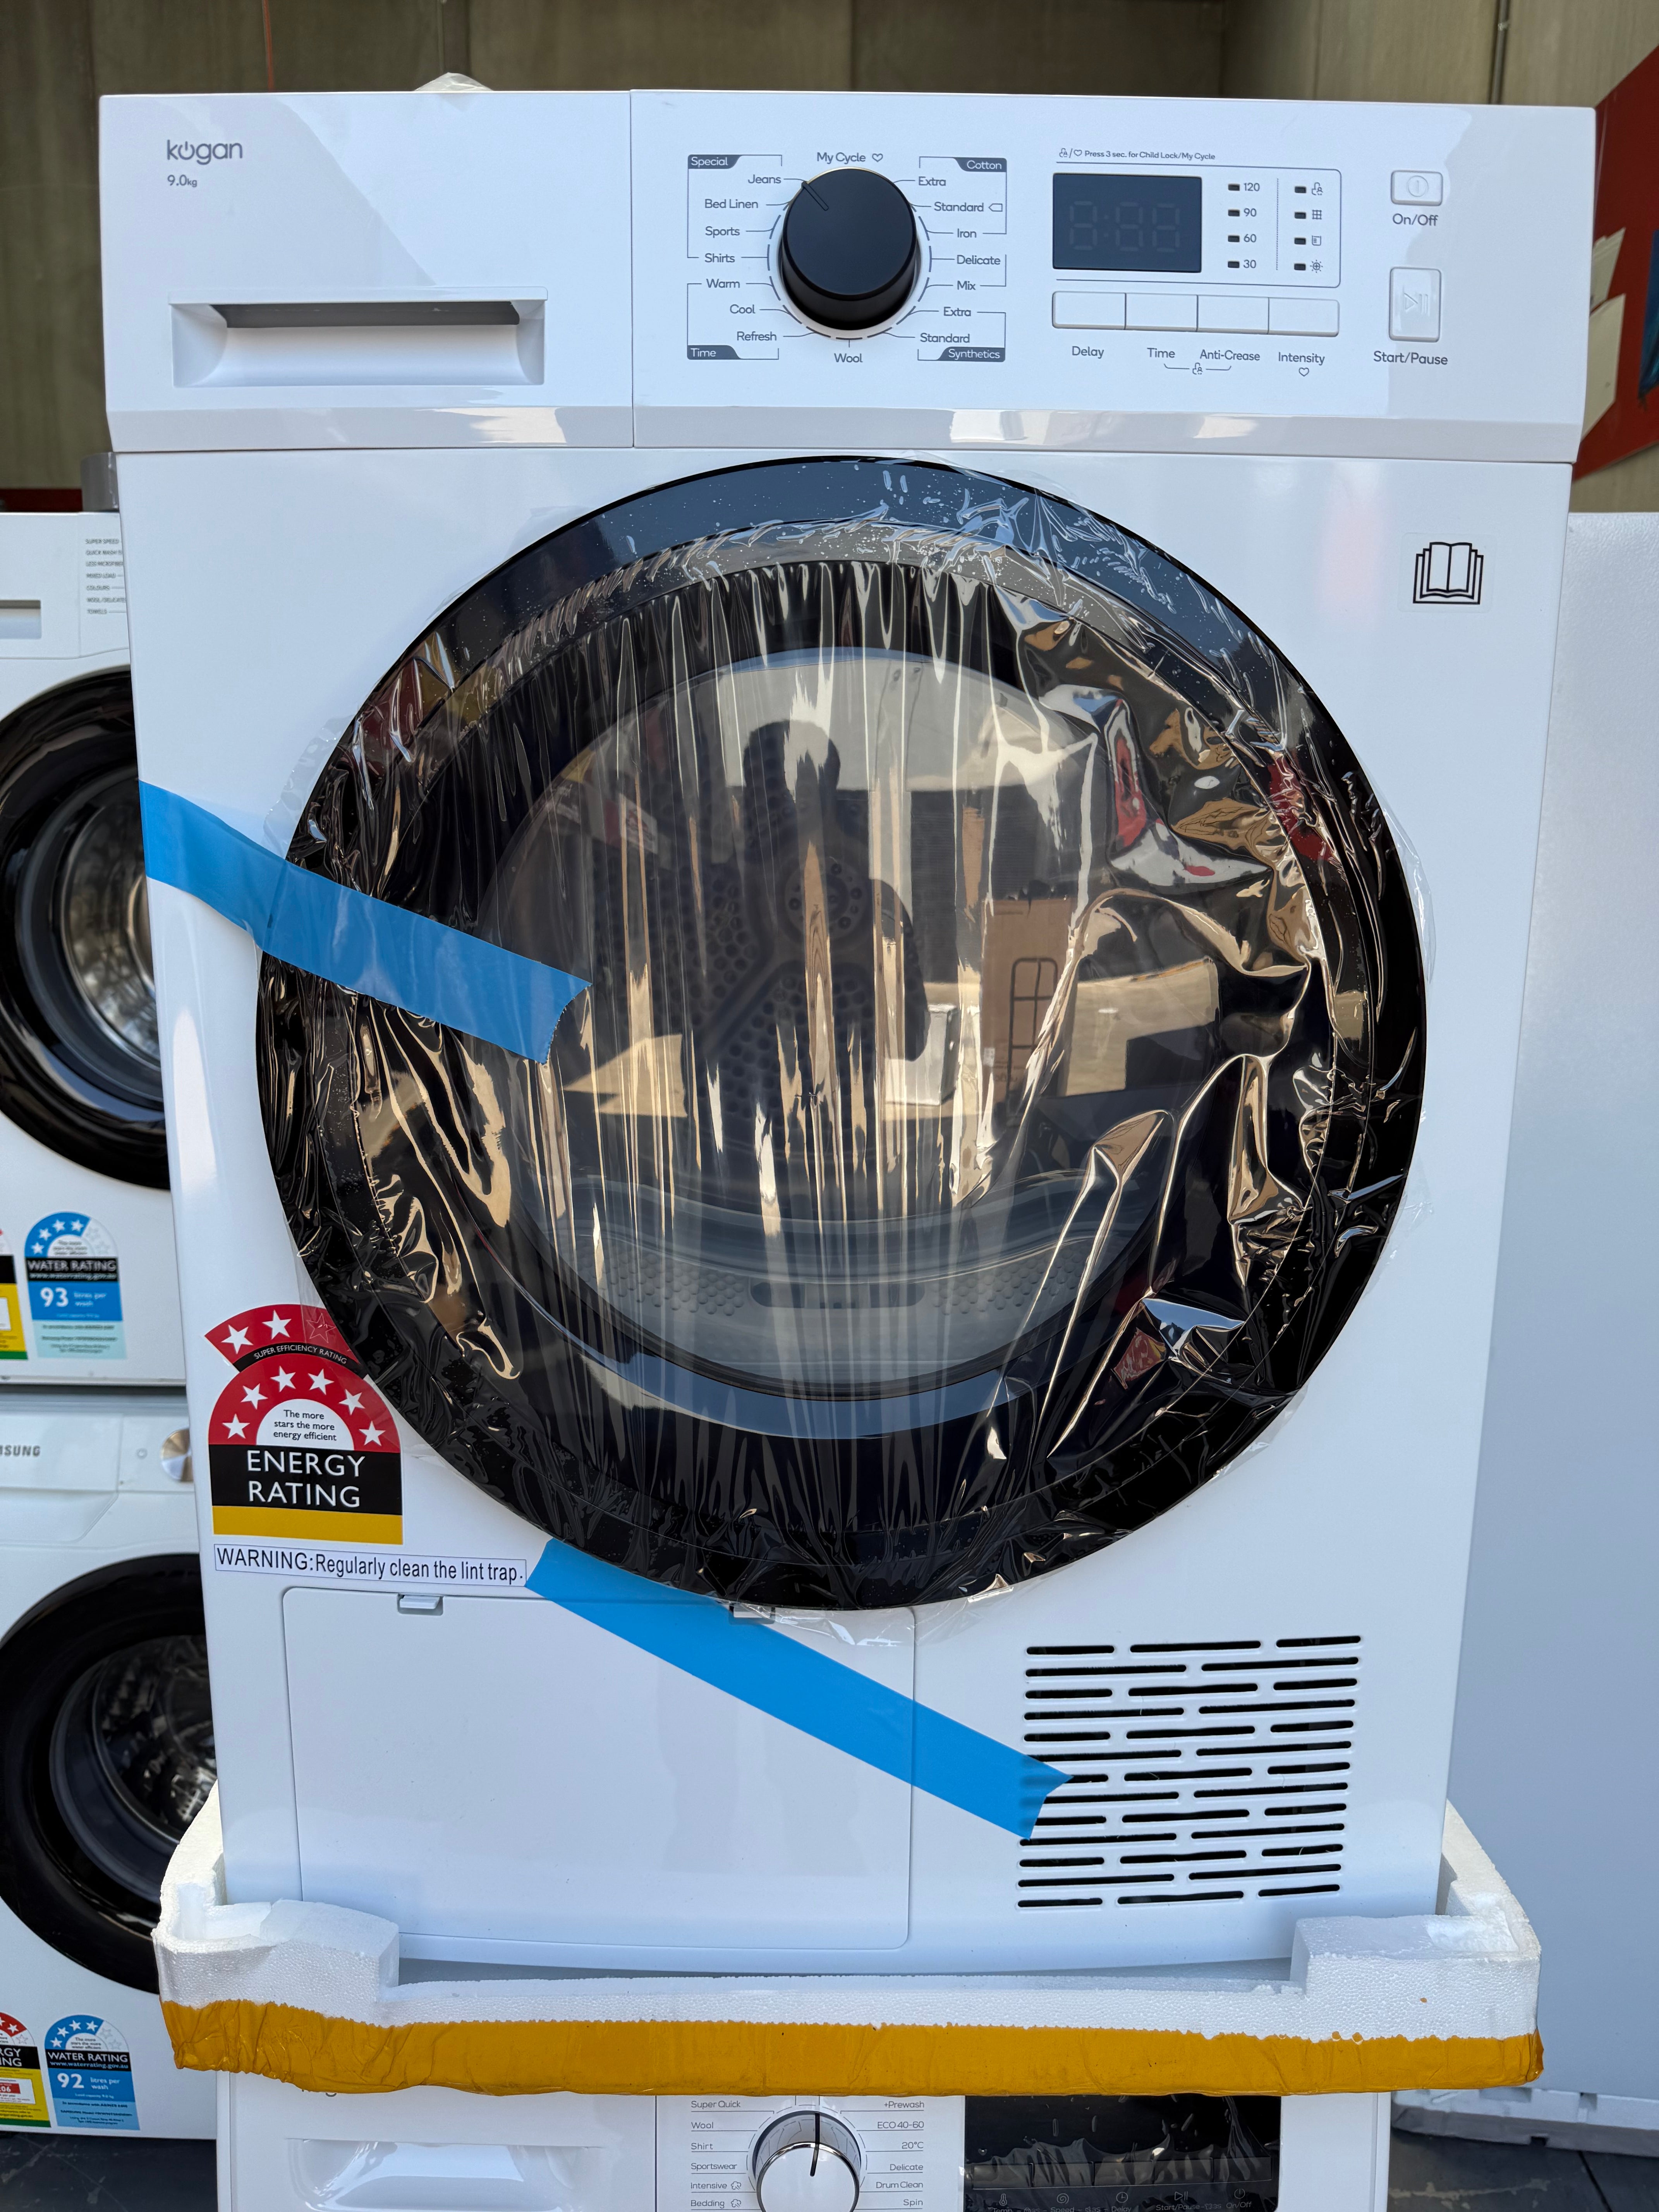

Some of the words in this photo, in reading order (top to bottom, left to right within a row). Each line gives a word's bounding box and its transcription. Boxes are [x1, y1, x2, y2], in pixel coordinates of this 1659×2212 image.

[167, 139, 243, 165] kogan
[1161, 152, 1193, 160] Lock/My
[1194, 153, 1215, 161] Cycle
[691, 156, 728, 167] Special
[817, 152, 833, 164] My
[836, 152, 866, 164] Cycle
[967, 160, 1002, 170] Cotton
[167, 175, 198, 187] 9.0kg
[748, 175, 781, 184] Jeans
[919, 177, 946, 187] Extra
[1243, 182, 1261, 192] 120
[705, 199, 727, 209] Bed
[729, 199, 758, 209] Linen
[934, 202, 984, 212] Standard
[1243, 208, 1257, 218] 90
[1392, 213, 1439, 226] On/Off
[705, 227, 740, 238] Sports
[957, 229, 977, 239] Iron
[1243, 234, 1257, 244] 60
[704, 253, 735, 263] Shirts
[957, 255, 1001, 266] Delicate
[1243, 260, 1257, 270] 30
[706, 279, 740, 289] Warm
[957, 281, 976, 291] Mix
[730, 305, 755, 314] Cool
[943, 307, 971, 317] Extra
[737, 331, 777, 342] Refresh
[920, 333, 970, 343] Standard
[690, 349, 716, 358] Time
[948, 349, 1000, 360] Synthetics
[1072, 346, 1104, 359] Delay
[1147, 348, 1175, 359] Time
[1200, 349, 1261, 362] Anti-Crease
[1373, 350, 1448, 365] Start/Pause
[834, 354, 863, 364] Wool
[1278, 352, 1325, 366] Intensity
[27, 1260, 69, 1271] WATER
[70, 1260, 116, 1272] RATING
[40, 1287, 69, 1307] 93
[254, 1348, 276, 1359] SUPER
[276, 1345, 318, 1353] EFFICIENCY
[319, 1348, 347, 1364] RATING
[283, 1410, 301, 1418] The
[297, 1421, 309, 1429] the
[273, 1431, 302, 1441] energy
[304, 1431, 337, 1441] efficient
[0, 1445, 40, 1456] SUNG
[247, 1450, 365, 1477] ENERGY
[249, 1480, 360, 1508] RATING
[390, 1560, 429, 1577] clean
[434, 1561, 457, 1579] the
[462, 1563, 484, 1580] lint
[488, 1565, 523, 1585] trap.
[48, 2052, 85, 2061] WATER
[88, 2053, 128, 2062] RATING
[57, 2073, 84, 2088] 92
[691, 2101, 716, 2110] Super
[718, 2100, 741, 2109] Quick
[884, 2101, 924, 2109] +Prewash
[691, 2162, 737, 2171] Sportswear
[691, 2199, 725, 2209] Bedding
[903, 2199, 923, 2208] Spin
